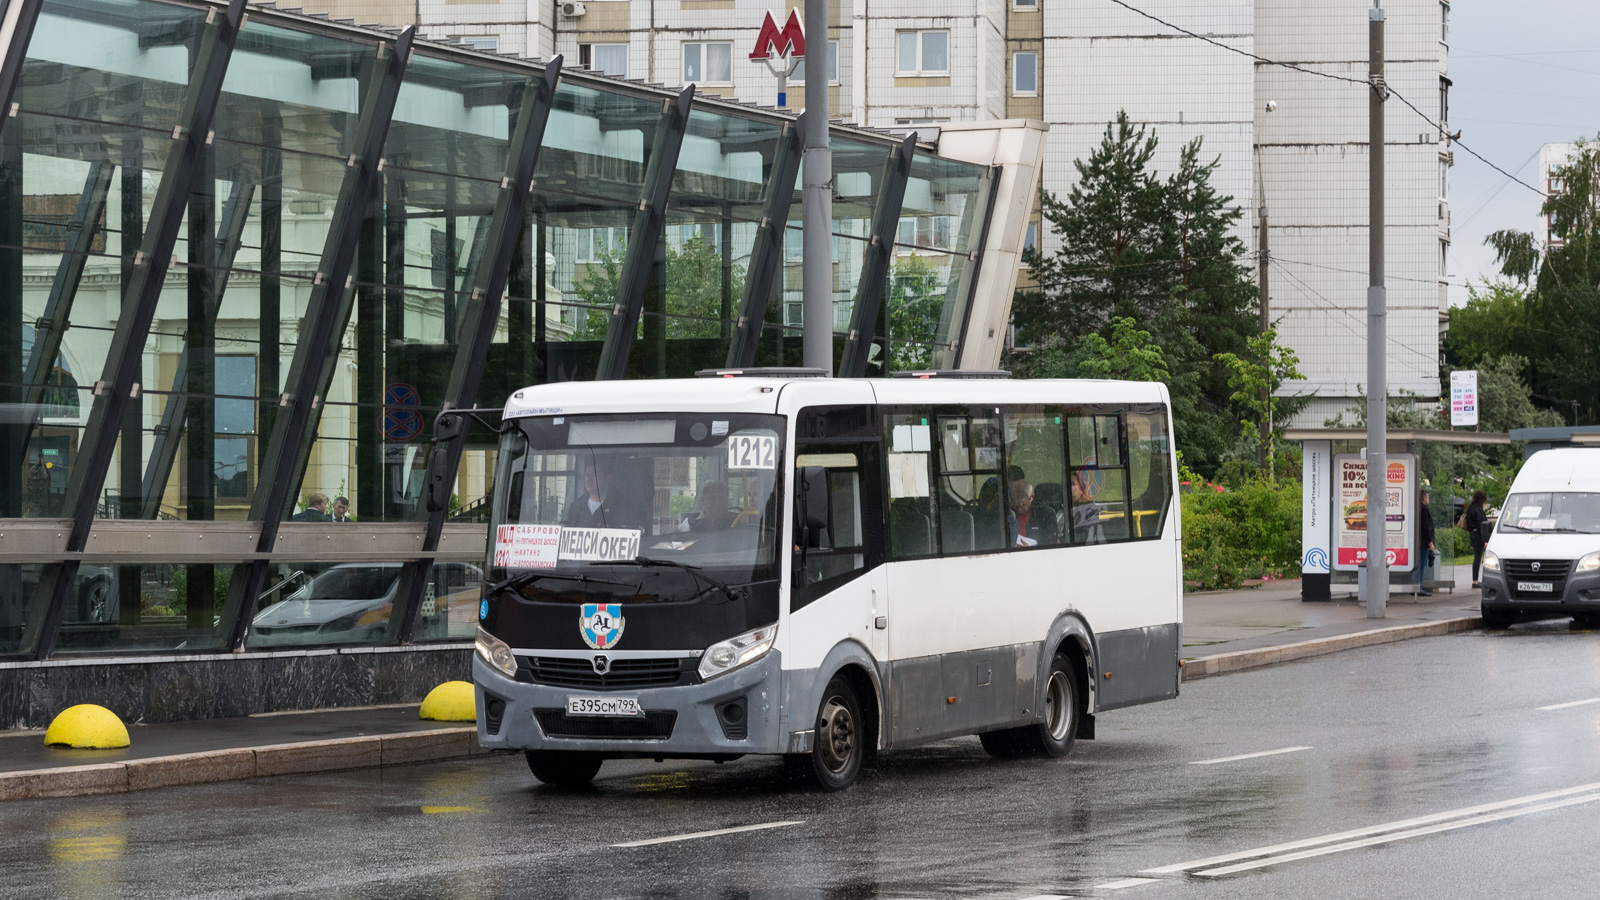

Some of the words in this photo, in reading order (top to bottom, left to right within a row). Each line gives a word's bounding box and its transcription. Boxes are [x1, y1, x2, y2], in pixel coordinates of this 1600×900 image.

[730, 438, 773, 466] 1212
[1343, 471, 1365, 481] 10%
[516, 526, 559, 535] САБУРОВО
[561, 530, 598, 558] МЕДСИ
[600, 532, 638, 560] ОКЕЙ
[520, 548, 540, 557] МИТИНО
[572, 700, 616, 712] Е395СМ
[618, 700, 634, 709] 799
